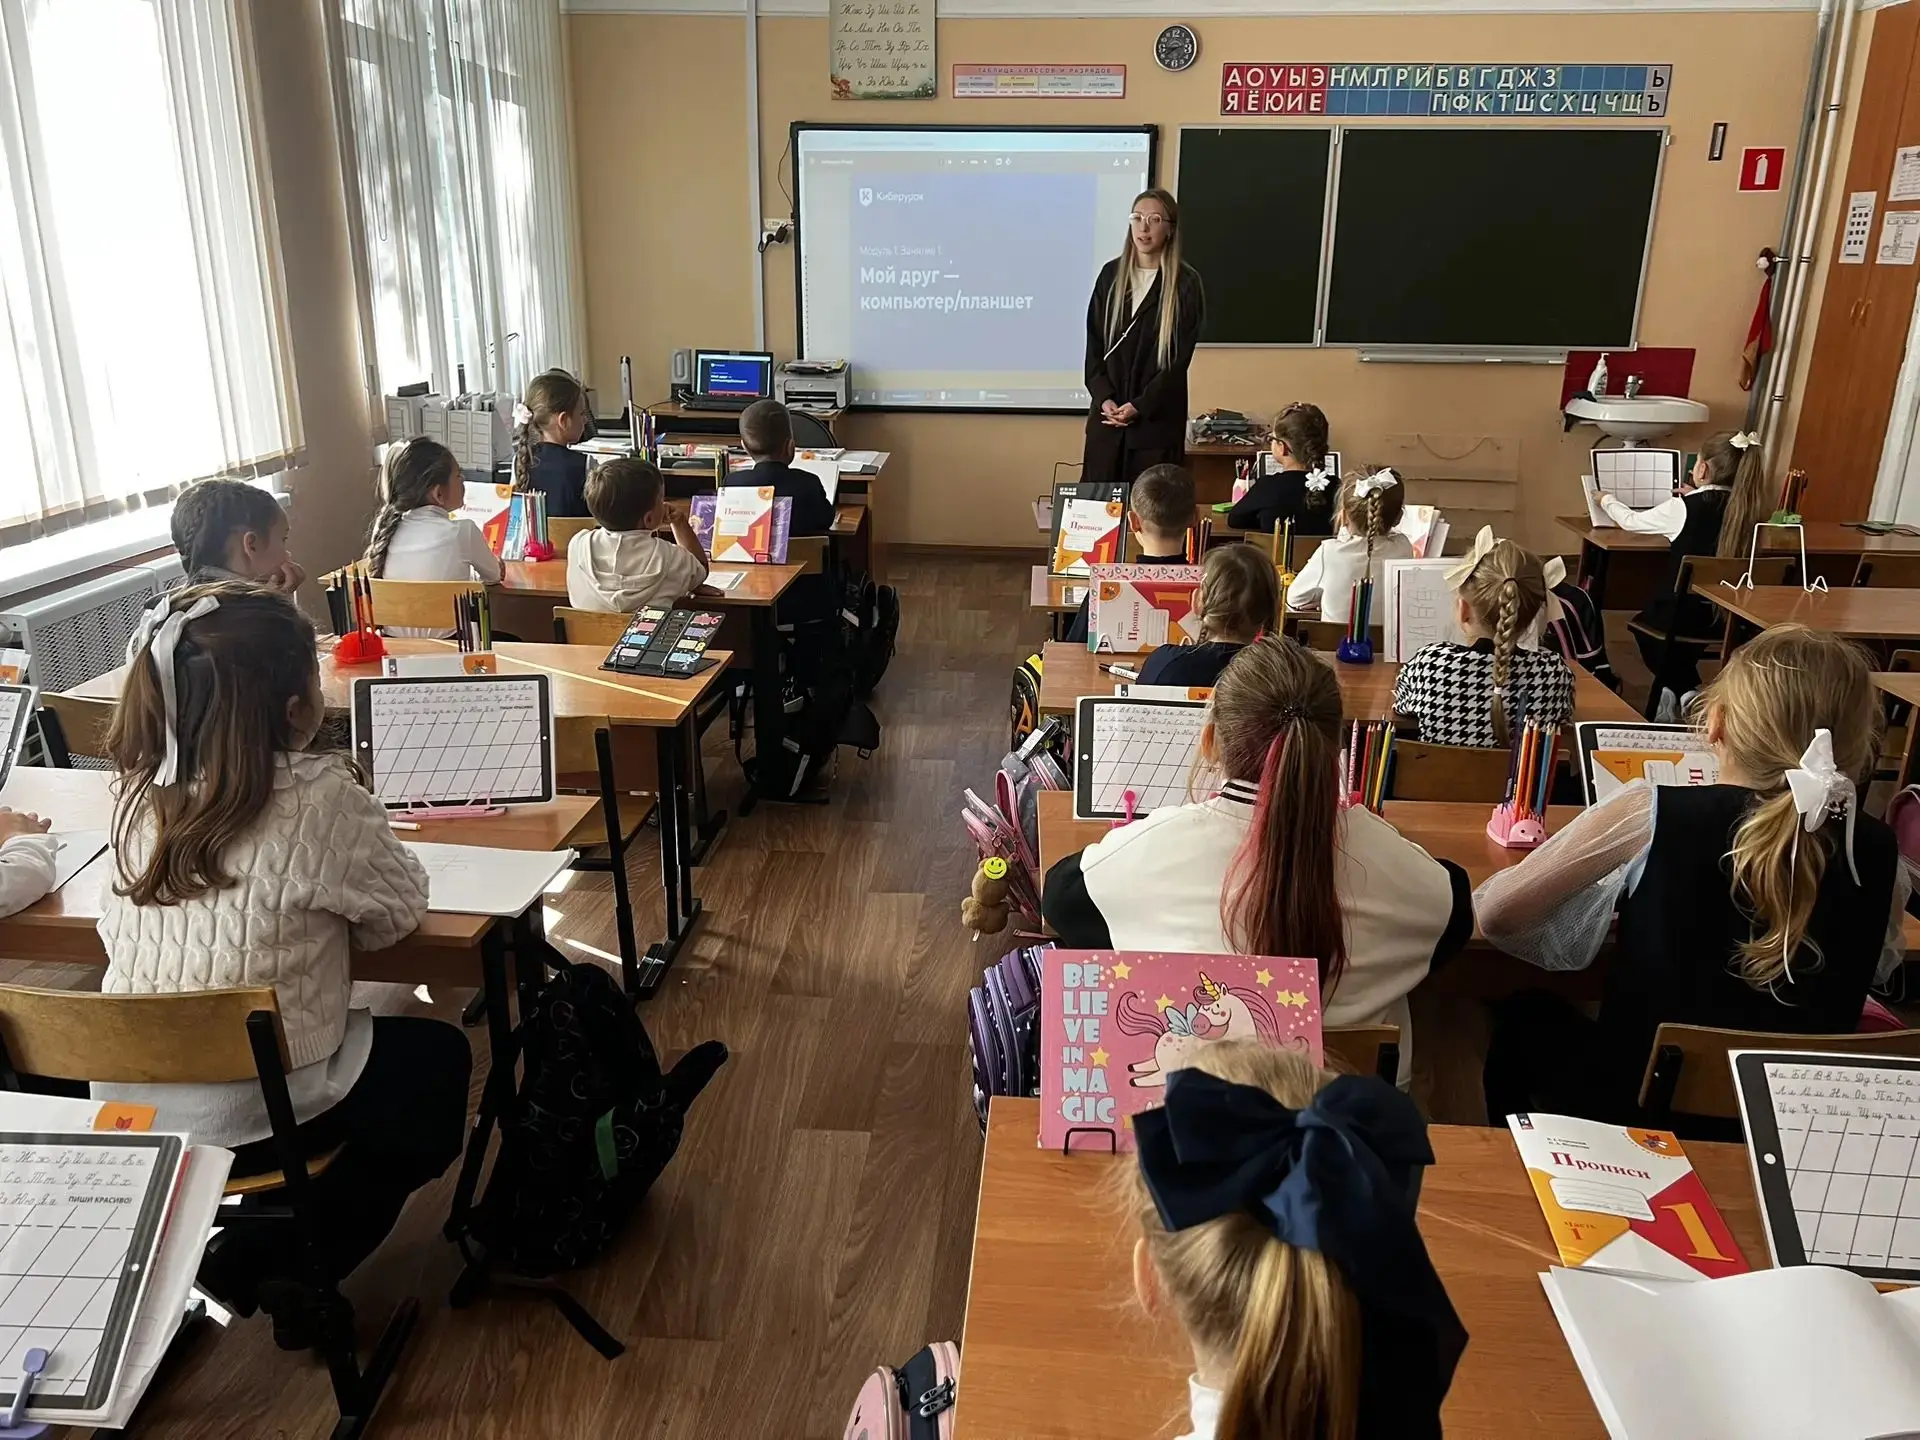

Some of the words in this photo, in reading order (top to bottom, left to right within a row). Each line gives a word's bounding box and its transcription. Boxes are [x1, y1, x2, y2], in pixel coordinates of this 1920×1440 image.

[876, 190, 924, 203] Киберурок
[860, 265, 896, 284] Мой
[900, 269, 940, 288] друг
[860, 290, 1034, 314] компьютер/планшет
[750, 524, 764, 551] 1
[1070, 520, 1103, 532] Прописи
[1127, 601, 1140, 641] Прописи
[1062, 963, 1100, 988] BE
[1062, 991, 1109, 1016] LIE
[1062, 1018, 1100, 1043] VE
[1062, 1046, 1084, 1064] IN
[1063, 1068, 1109, 1093] MA
[1062, 1097, 1116, 1124] GIC
[1550, 1151, 1652, 1180] Прописи
[69, 1195, 93, 1204] ПИШИ
[94, 1196, 133, 1205] КРАСИВО!
[1660, 1202, 1736, 1263] 1
